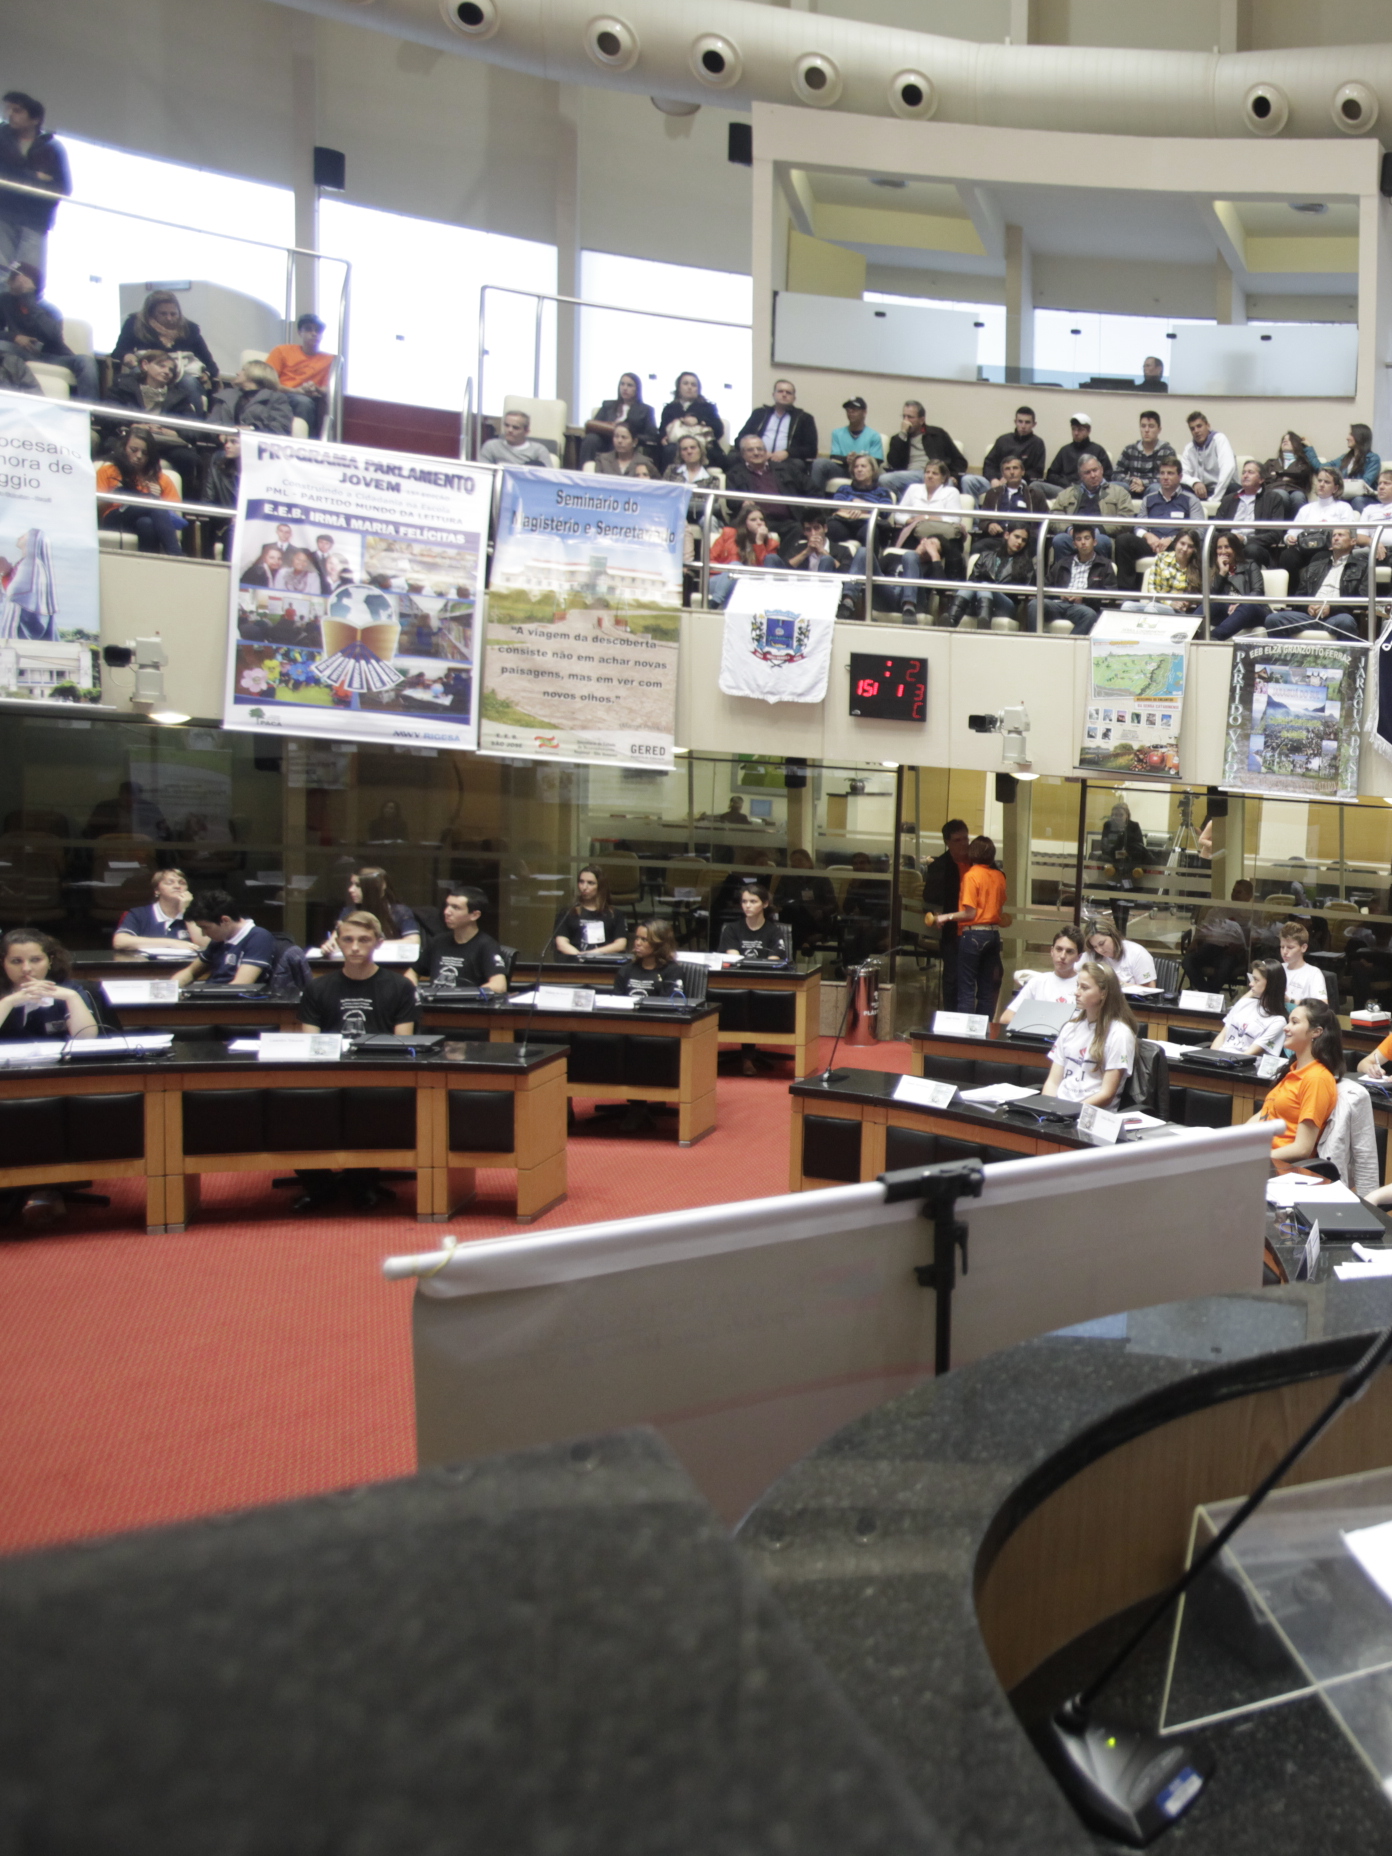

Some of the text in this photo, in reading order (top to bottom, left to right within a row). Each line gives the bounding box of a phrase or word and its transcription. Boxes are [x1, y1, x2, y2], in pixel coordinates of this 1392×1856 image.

[49, 460, 73, 475] de
[258, 441, 475, 495] PROGRAMA PARLAMENTO
[339, 472, 401, 494] JOVEM
[265, 486, 290, 497] PML
[301, 493, 352, 508] PARTIDO
[355, 503, 396, 515] MUNDO
[399, 510, 414, 518] DA
[418, 512, 463, 525] LEITURA
[282, 478, 343, 497] Construindo
[355, 492, 405, 507] Cidadania
[420, 503, 451, 514] Escola
[556, 489, 639, 514] Seminário do
[263, 503, 466, 544] E.E.B. IRMÃ MARIA FELÍCITAS
[512, 510, 676, 544] Magistério e Secretarado
[528, 628, 571, 641] viagem
[574, 633, 589, 643] da
[592, 635, 657, 649] descoberta
[498, 645, 668, 669] consiste não em achar novas
[1249, 647, 1263, 659] EEB
[1265, 644, 1282, 655] ELZA
[1283, 645, 1324, 656] GRANZOTTO
[501, 666, 663, 689] paisagens, mas em ver com
[1229, 651, 1246, 725] PARTIDO
[543, 690, 577, 700] novos
[630, 744, 666, 756] GERED
